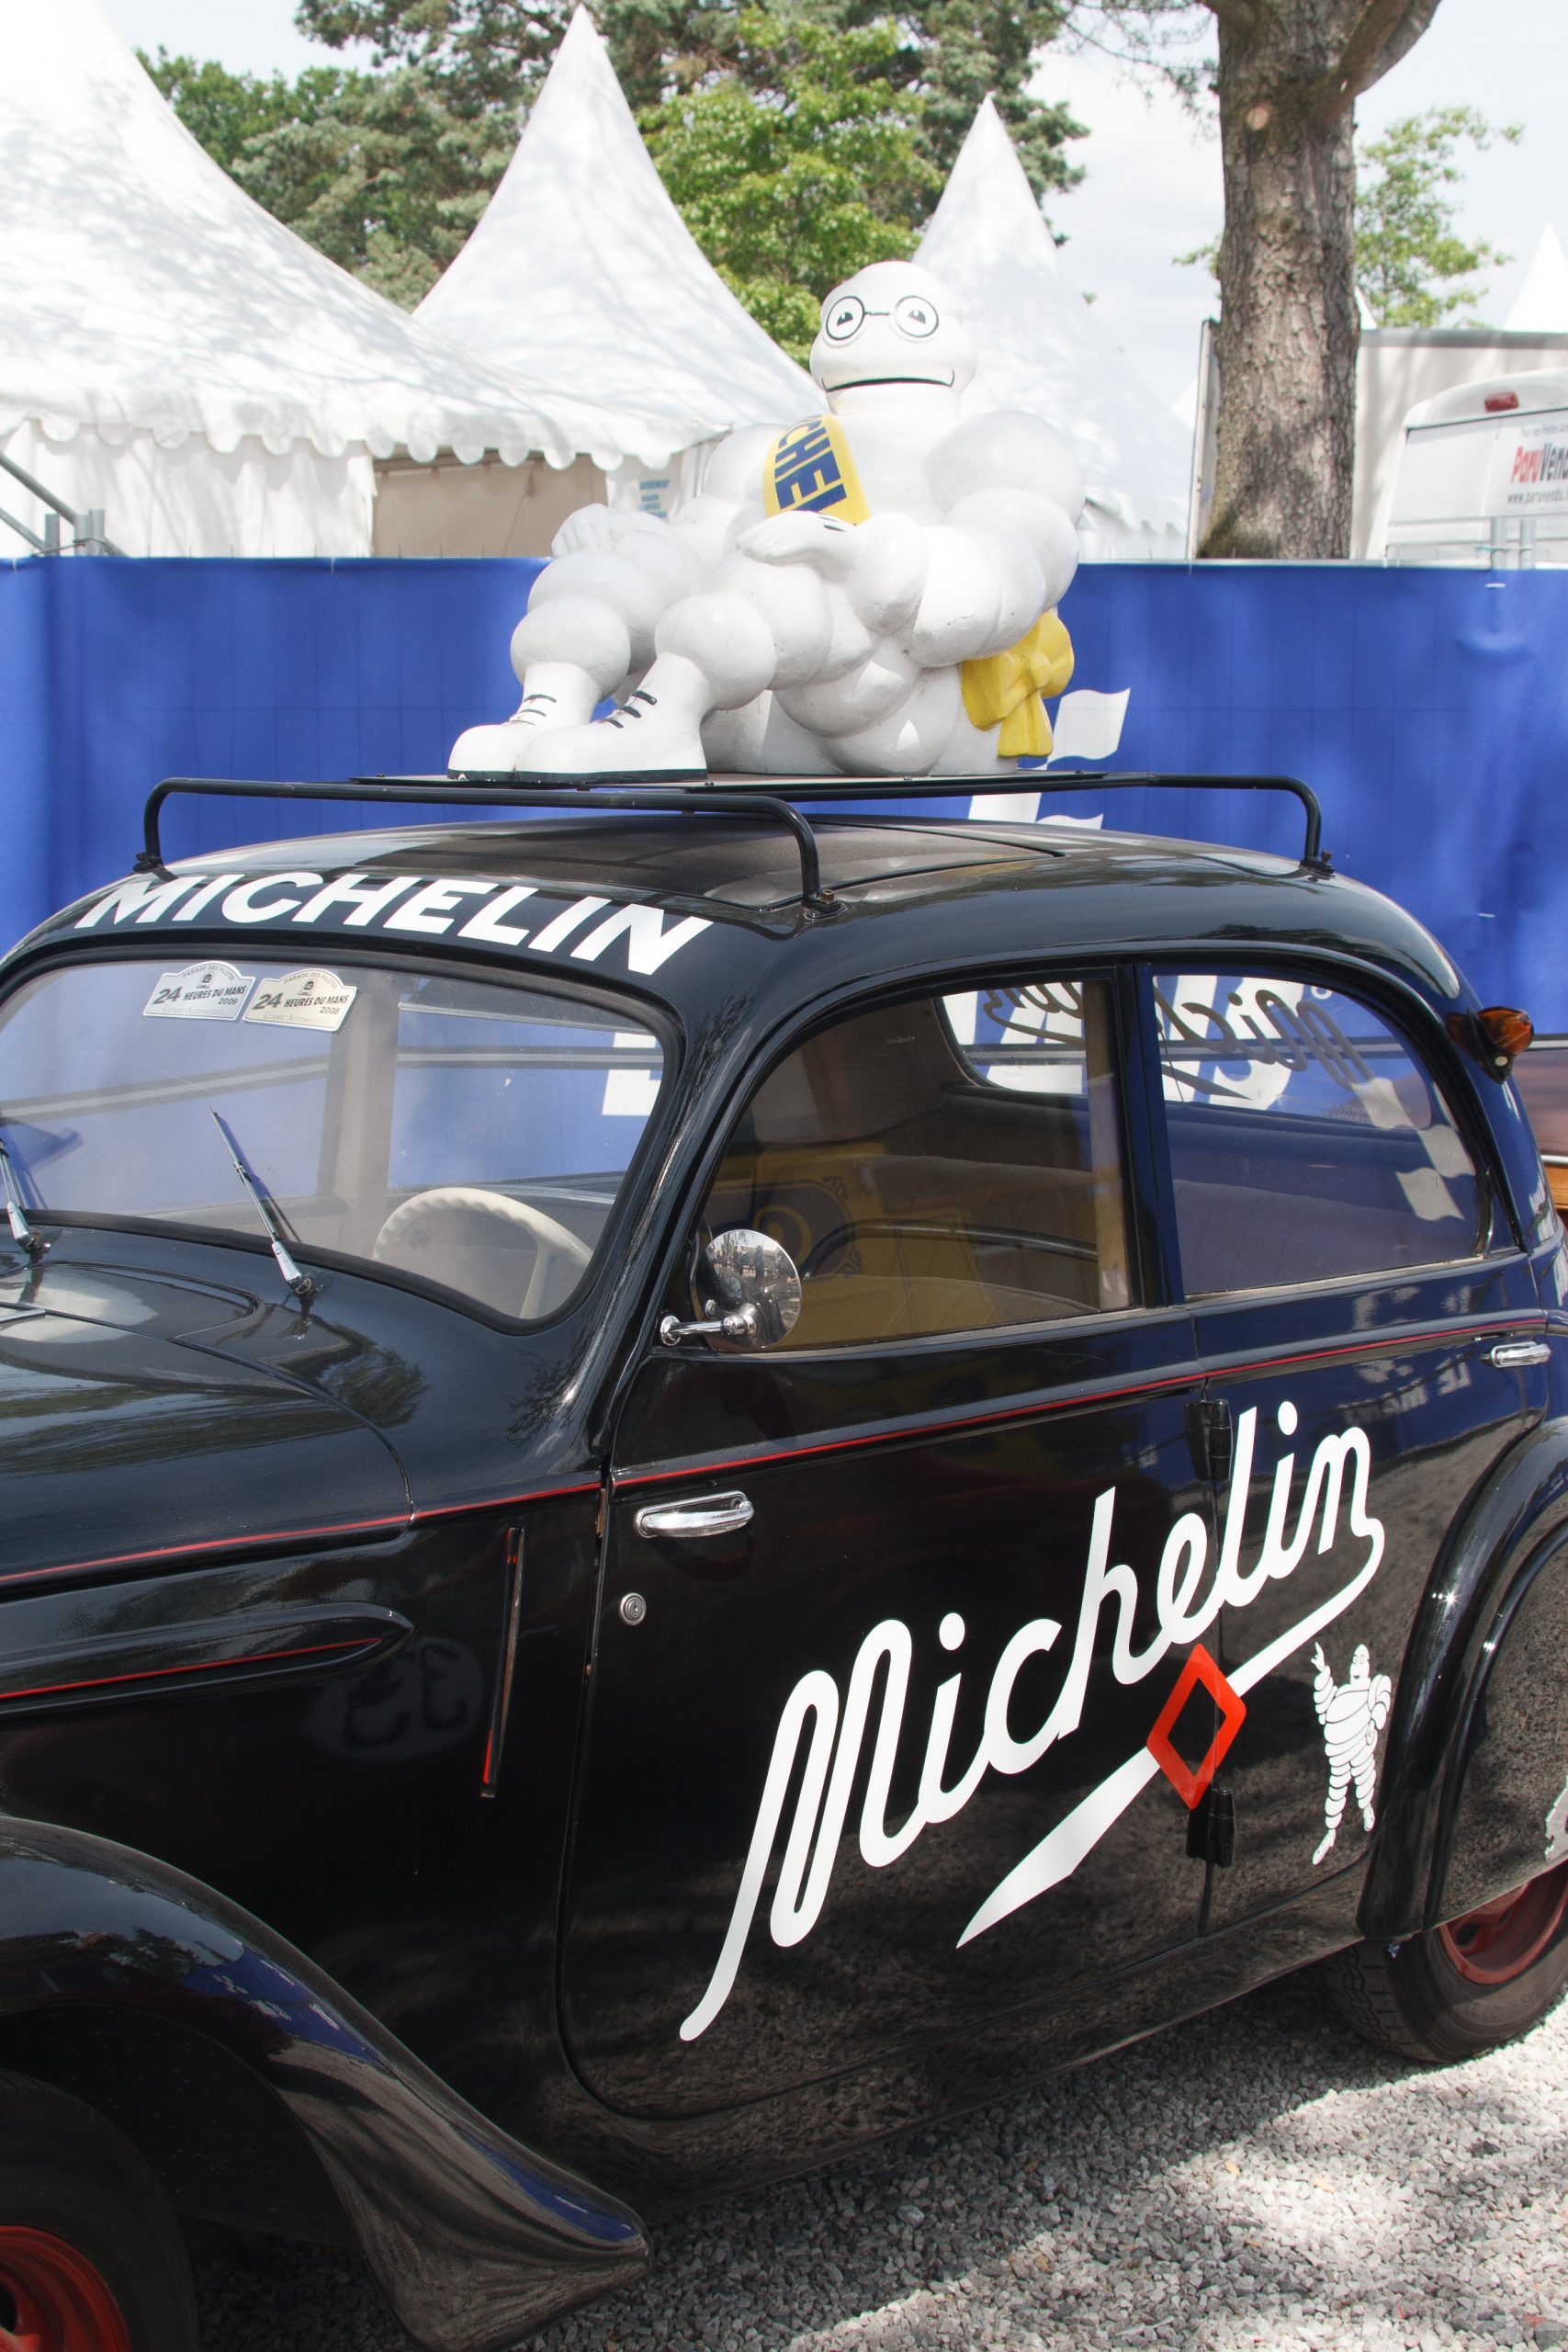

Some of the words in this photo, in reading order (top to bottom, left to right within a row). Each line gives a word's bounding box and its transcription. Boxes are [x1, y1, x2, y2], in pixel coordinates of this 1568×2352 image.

[74, 871, 714, 976] MICHELIN
[152, 987, 182, 1004] 24
[183, 989, 211, 1001] HEURES
[211, 988, 223, 998] DU
[223, 985, 248, 996] MANS
[218, 997, 238, 1006] 2009
[253, 993, 282, 1010] 24
[284, 996, 313, 1008] HEURES
[313, 996, 325, 1005] DU
[325, 995, 349, 1004] MANS
[319, 1006, 340, 1014] 2008
[679, 1400, 1385, 2041] Michelin
